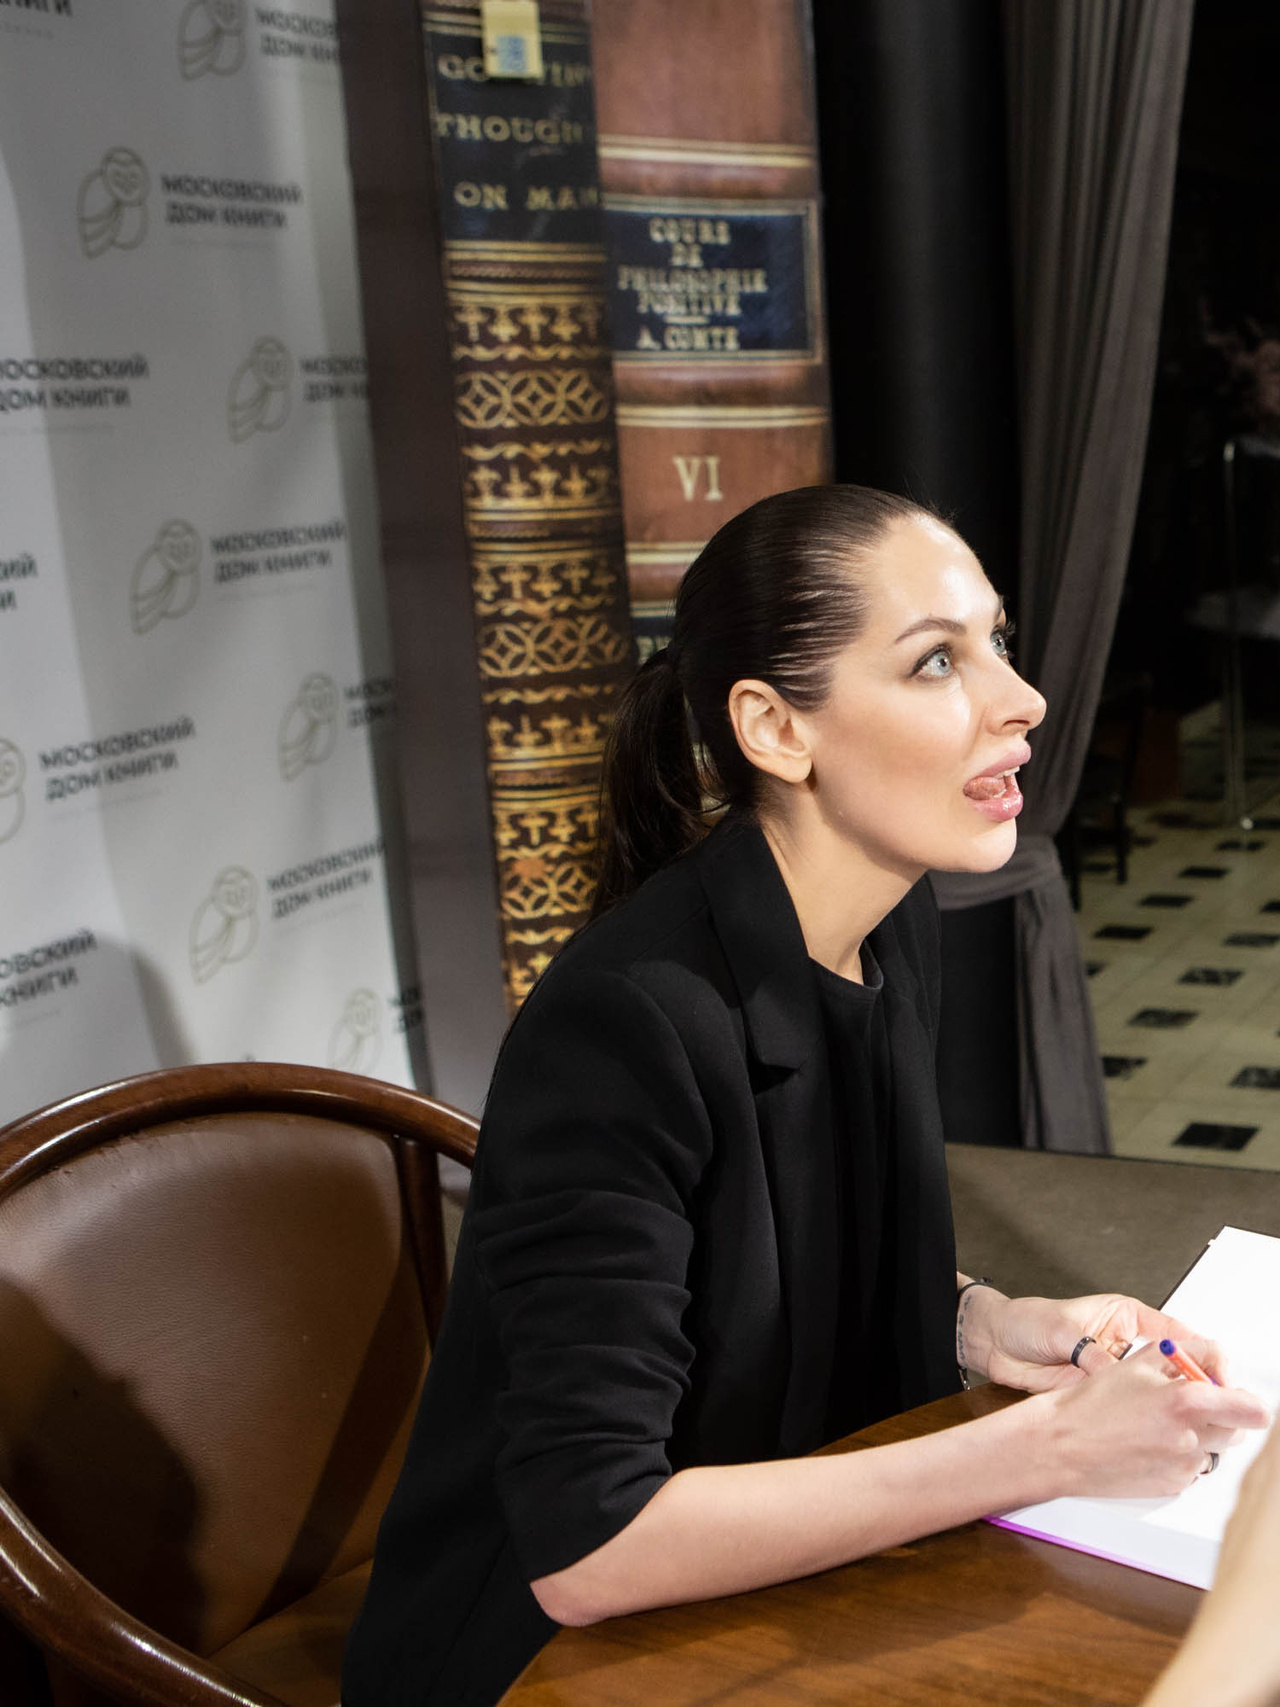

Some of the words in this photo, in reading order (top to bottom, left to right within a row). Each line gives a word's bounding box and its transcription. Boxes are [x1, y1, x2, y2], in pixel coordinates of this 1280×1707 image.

[160, 174, 303, 204] МОСКОВСКИЙ
[453, 181, 508, 211] ON
[166, 201, 217, 225] ДОМ
[220, 205, 287, 228] КНИГИ
[0, 353, 150, 381] ОСКОВСКИЙ
[50, 386, 132, 409] КНИГИ
[674, 455, 723, 502] VI
[209, 517, 347, 556] МОСКОВСКИЙ
[213, 558, 260, 584] ДОМ
[263, 549, 333, 573] КНИГИ
[38, 714, 196, 771] МОСКОВСКИЙ
[45, 768, 103, 802] ДОМ
[104, 750, 180, 785] КНИГИ
